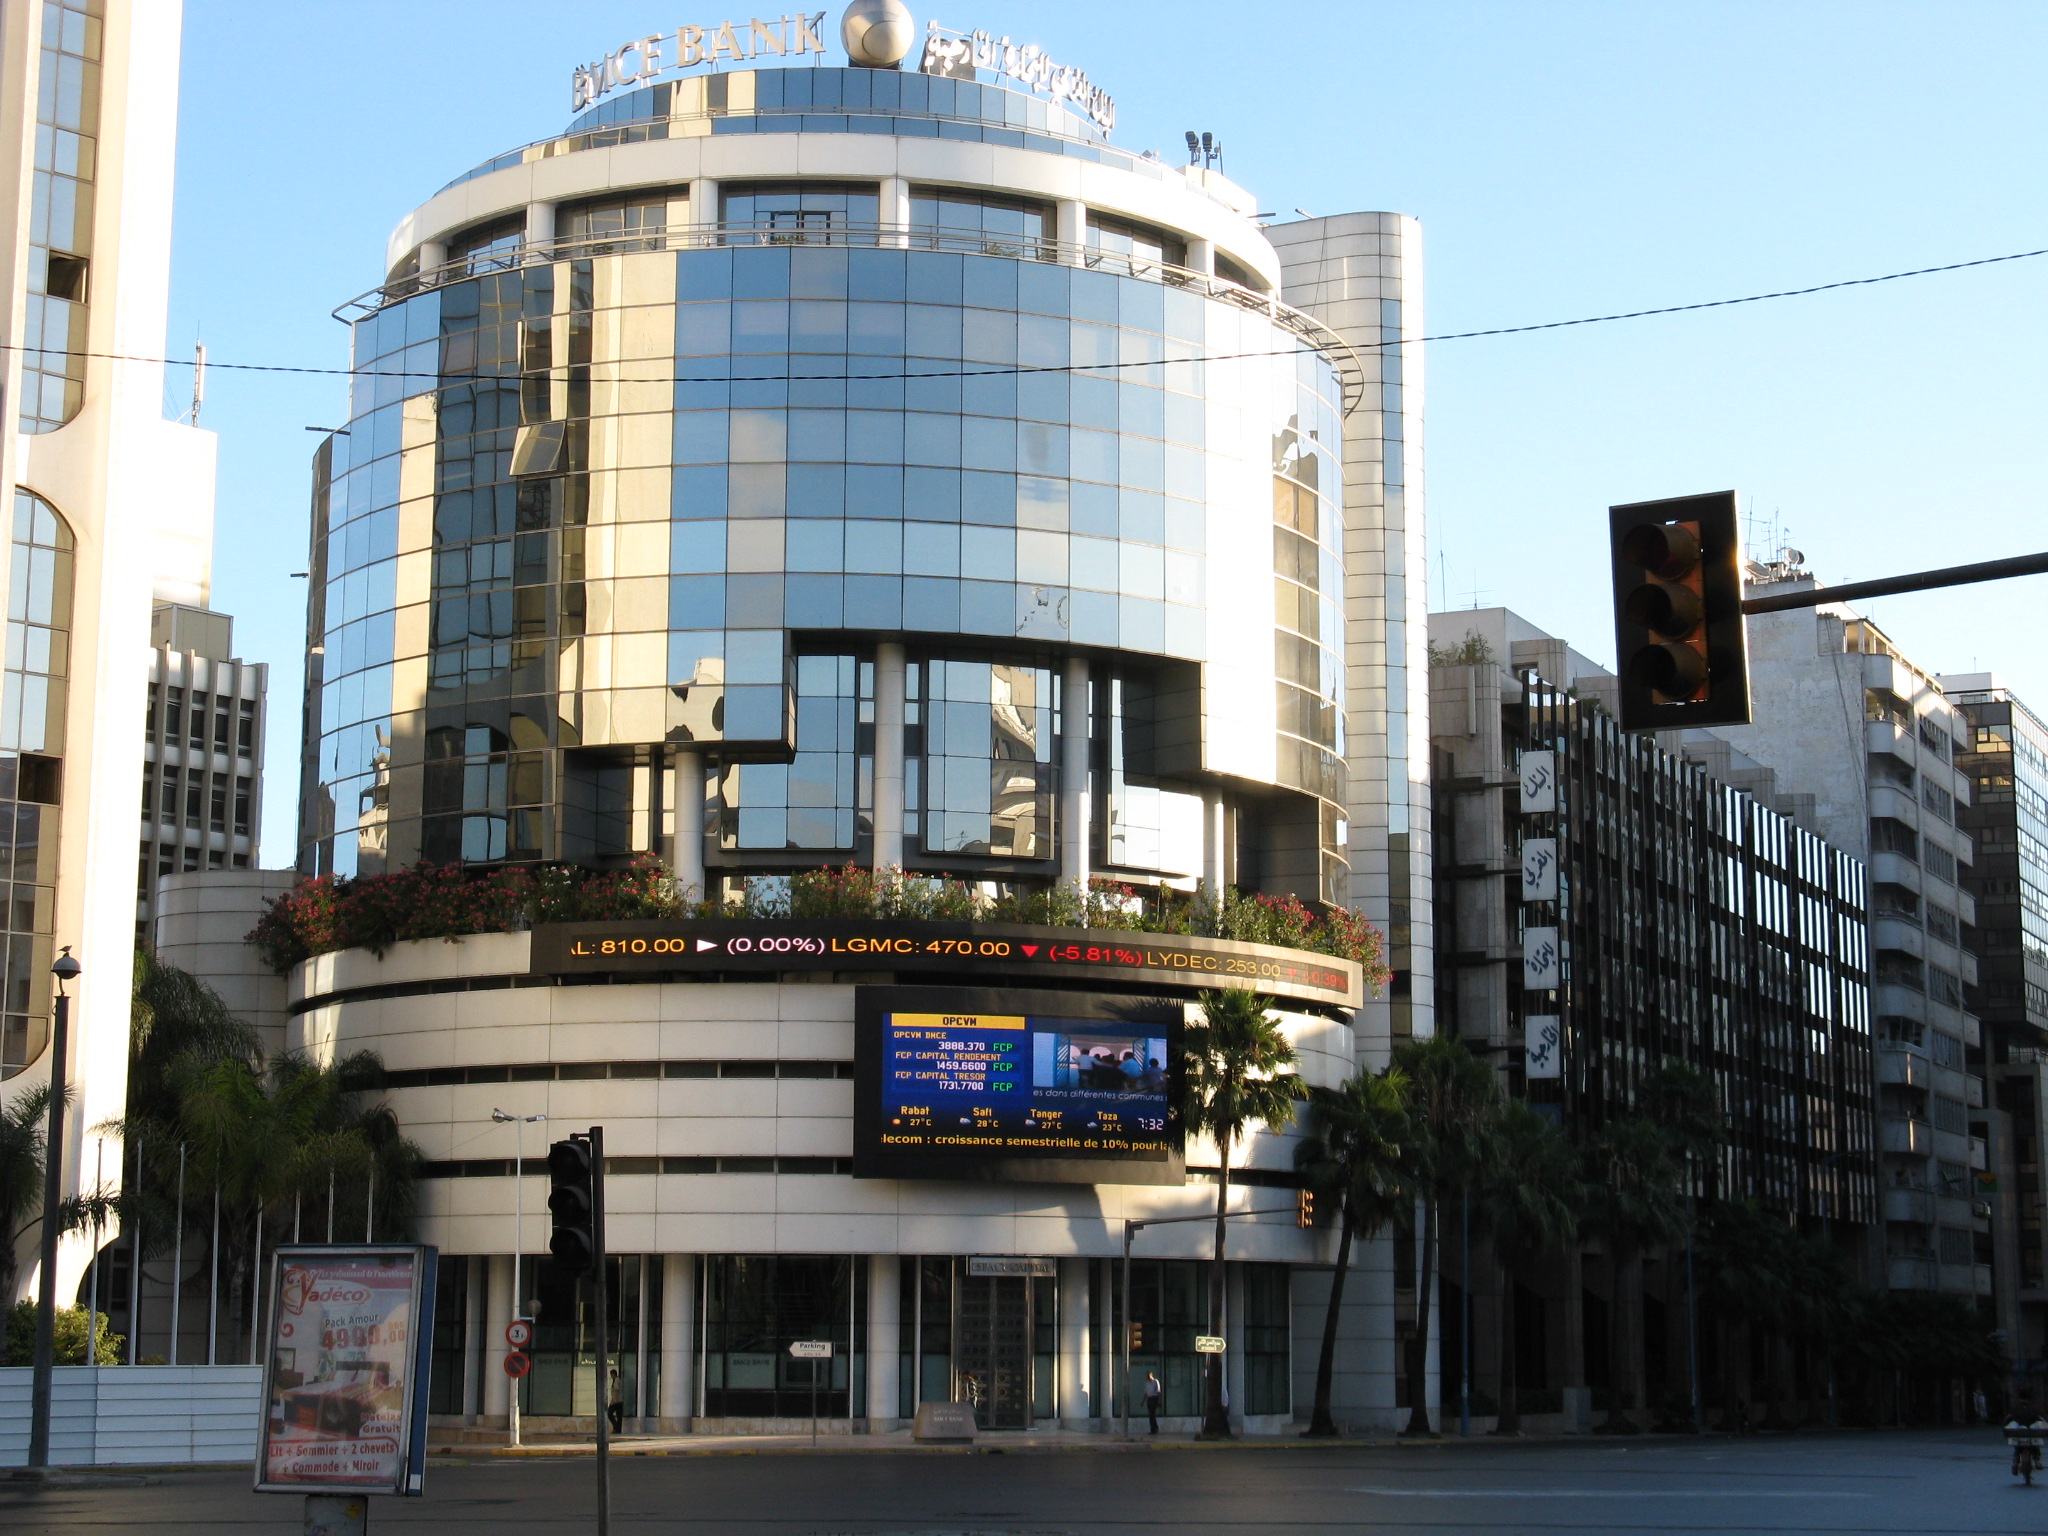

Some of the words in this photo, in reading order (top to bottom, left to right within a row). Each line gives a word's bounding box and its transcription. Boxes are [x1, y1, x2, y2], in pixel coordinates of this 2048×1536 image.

[572, 33, 662, 113] BMCE
[677, 11, 826, 68] BANK
[1522, 765, 1552, 800] البنك
[601, 938, 685, 955] 810.00
[727, 937, 825, 955] (0.00%)
[831, 937, 920, 954] LGMC:
[926, 940, 1010, 956] 470.00
[1049, 944, 1143, 967] (-5.81%)
[1147, 951, 1222, 971] LYDEC:
[1226, 958, 1281, 978] 253.00
[942, 1016, 977, 1026] OPCVM
[893, 1031, 922, 1039] OPCVM
[938, 1041, 985, 1051] 3888.370
[993, 1043, 1013, 1052] FCP
[895, 1051, 912, 1059] FCP
[915, 1051, 950, 1060] CAPITAL
[954, 1053, 1001, 1061] RENDEMENT
[936, 1061, 987, 1071] 1459.6600
[993, 1062, 1013, 1072] FCP
[895, 1071, 912, 1079] FCP
[915, 1071, 950, 1080] CAPITAL
[954, 1072, 986, 1081] TRESOR
[938, 1081, 984, 1091] 1731.7700
[993, 1082, 1013, 1092] FCP
[1045, 1089, 1068, 1098] dans
[1070, 1090, 1116, 1100] différentes
[1118, 1093, 1164, 1102] communes
[901, 1106, 930, 1115] Rabat
[973, 1107, 992, 1116] Safi
[1030, 1109, 1063, 1120] Tanger
[1097, 1111, 1118, 1121] Taza
[1137, 1118, 1164, 1131] 7:32
[880, 1134, 922, 1144] lecom
[935, 1135, 1003, 1145] croissance
[1007, 1136, 1081, 1148] semestrielle
[1084, 1139, 1099, 1148] de
[1102, 1140, 1129, 1149] 10%
[1132, 1142, 1158, 1151] pour
[325, 1318, 346, 1328] Pack
[348, 1314, 378, 1325] Amour
[799, 1343, 826, 1351] Parking
[363, 1424, 401, 1434] Gratuit
[270, 1446, 282, 1457] Lit
[296, 1443, 339, 1456] Sommier
[351, 1443, 357, 1454] 2
[360, 1442, 395, 1454] chevets
[292, 1459, 340, 1473] Commode
[353, 1458, 379, 1470] Miroir
